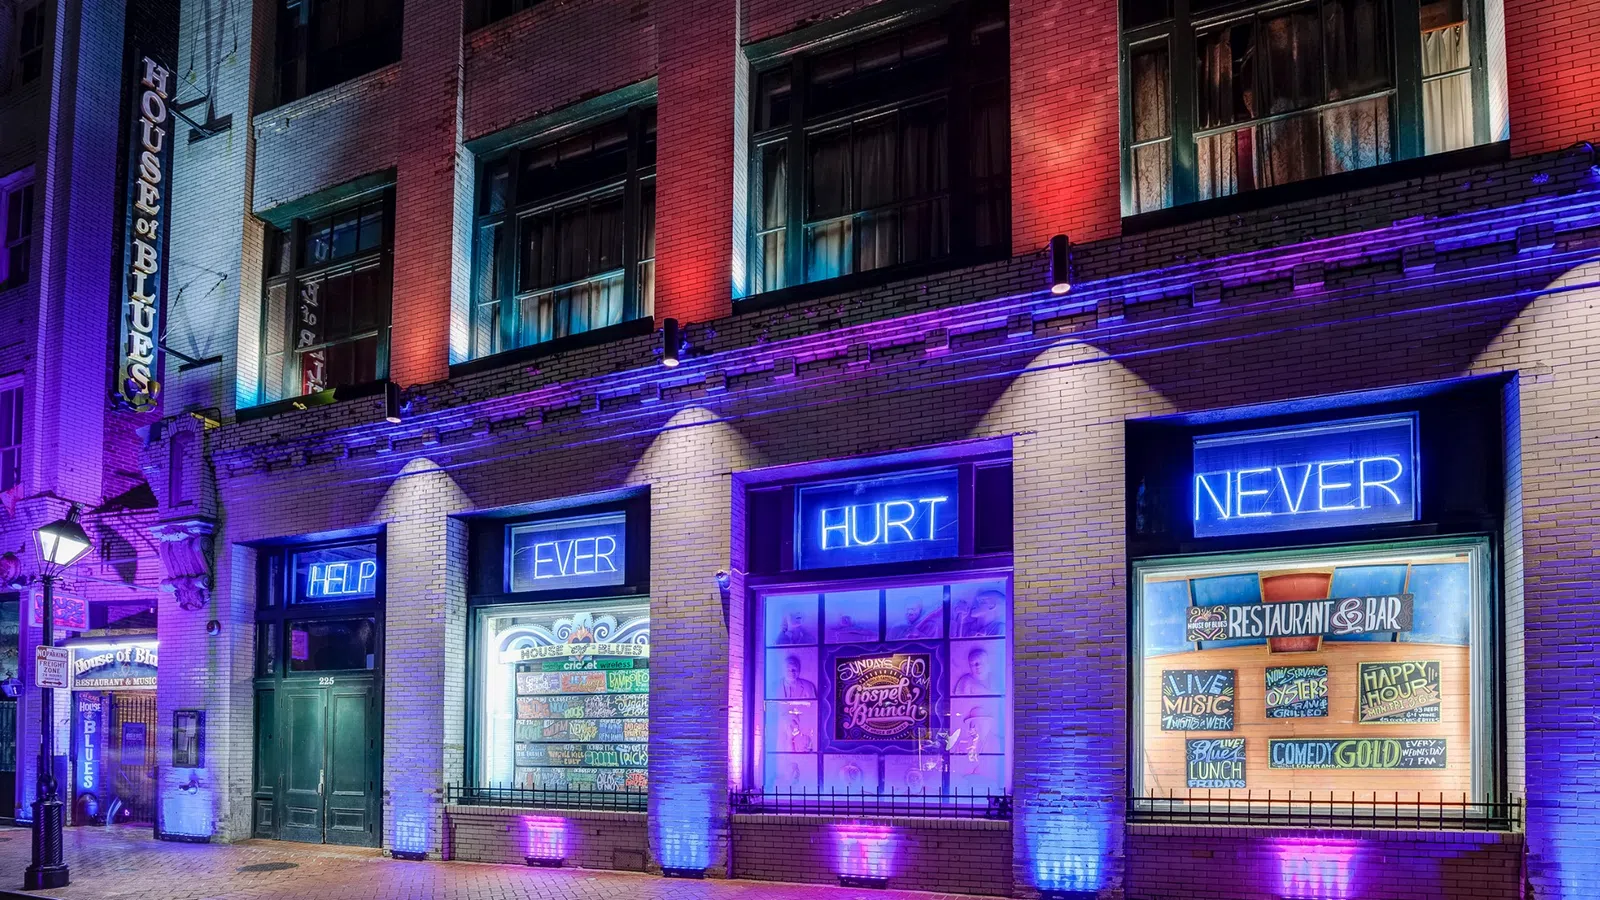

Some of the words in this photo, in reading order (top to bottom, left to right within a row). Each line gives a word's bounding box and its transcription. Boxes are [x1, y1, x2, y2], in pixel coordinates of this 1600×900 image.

[135, 55, 169, 215] HOUSE
[136, 217, 159, 239] of
[128, 239, 158, 394] BLUES
[1195, 457, 1403, 521] NEVER
[822, 497, 948, 550] HURT
[534, 535, 617, 579] EVER
[310, 560, 377, 596] HELP
[36, 595, 84, 612] USE
[1188, 621, 1204, 630] HOUSE
[1204, 621, 1212, 629] OF
[1212, 620, 1227, 629] BLUES
[1228, 600, 1335, 638] RESTAURANT
[1333, 598, 1364, 635] &
[1365, 597, 1402, 632] BAR
[37, 650, 47, 658] NO
[46, 649, 67, 659] PARKING
[74, 652, 114, 676] House
[116, 647, 132, 662] of
[520, 645, 564, 659] HOUSE
[598, 644, 643, 656] BLUES
[39, 660, 66, 669] FREIGHT
[563, 660, 598, 670] cricket
[601, 660, 631, 669] wireless
[837, 657, 893, 681] SUNDAYS
[905, 656, 926, 678] 10
[75, 678, 124, 687] RESTAURANT
[125, 678, 132, 686] &
[133, 677, 157, 686] MUSIC
[318, 677, 335, 686] 225
[1168, 673, 1227, 696] LIVE
[1266, 670, 1286, 686] NOW
[1280, 667, 1327, 683] SERVING
[1363, 661, 1428, 691] HAPPY
[845, 677, 918, 708] Gospel
[1266, 678, 1328, 706] OYSTERS
[1366, 678, 1432, 708] HOUR
[79, 702, 101, 712] HOUSE
[843, 700, 928, 729] Brunch
[1162, 695, 1233, 716] MUSIC
[1273, 709, 1322, 718] GRILLED
[1293, 700, 1320, 711] RAW
[1162, 716, 1173, 729] 7
[1206, 715, 1232, 729] WEEK
[1220, 738, 1244, 748] LIVE!
[1273, 742, 1338, 764] COMEDY
[1334, 739, 1402, 768] GOLD
[1402, 746, 1446, 757] WEDNESDAY
[1405, 739, 1436, 748] EVERY
[83, 720, 97, 789] BLUES
[1417, 756, 1437, 765] PM
[1190, 760, 1242, 780] LUNCH
[1188, 779, 1246, 788] FRIDAYS
